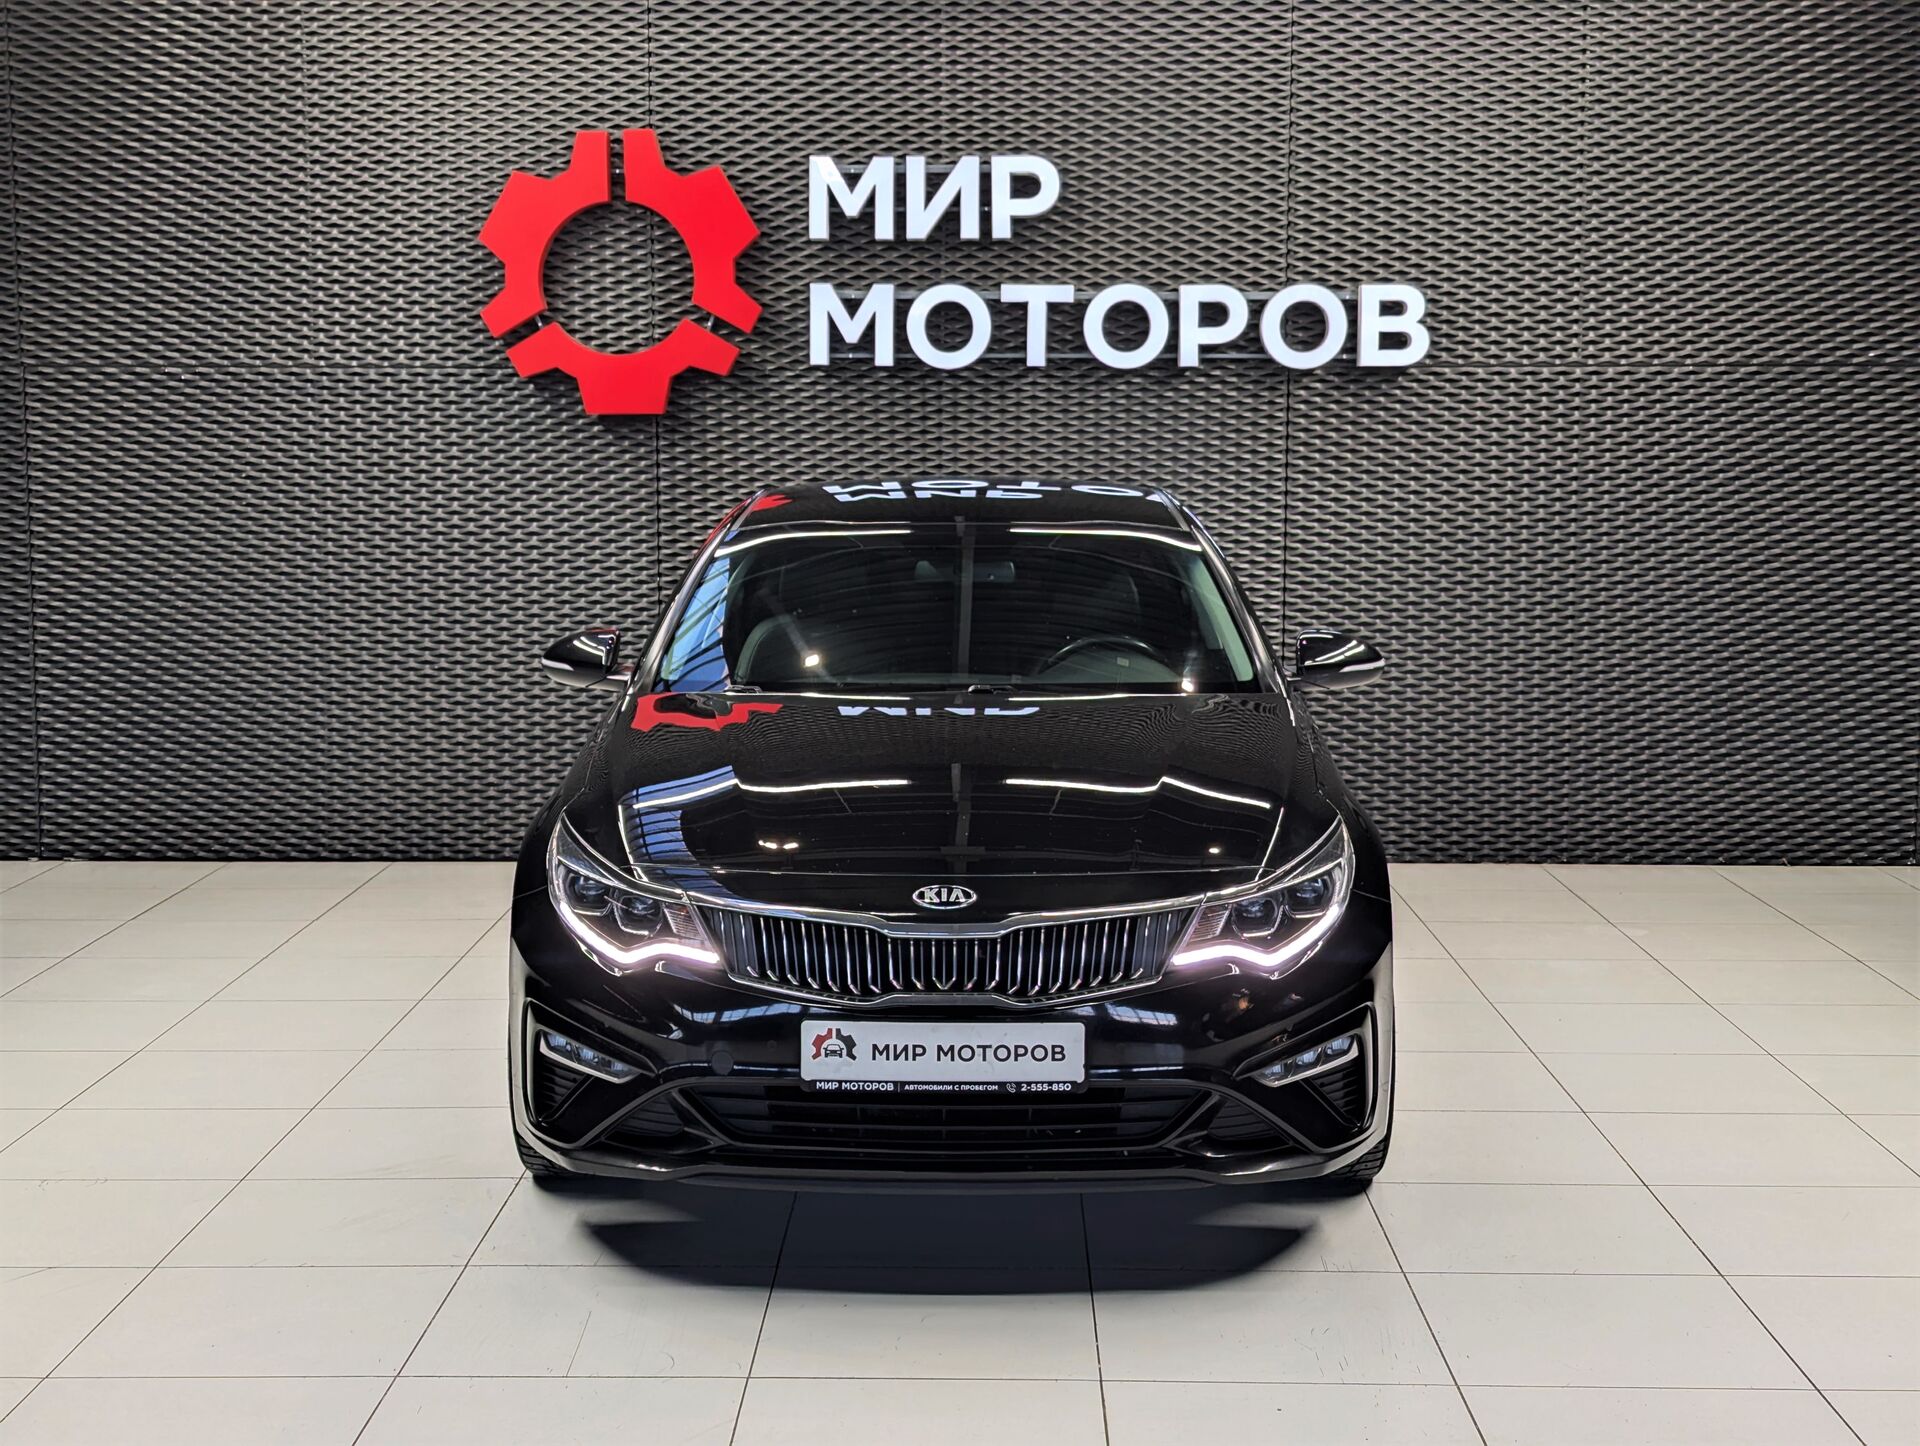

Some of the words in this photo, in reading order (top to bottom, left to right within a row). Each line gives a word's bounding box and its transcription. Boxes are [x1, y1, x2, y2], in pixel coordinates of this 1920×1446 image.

[808, 154, 1061, 241] МИР
[808, 282, 1432, 370] МОТОРОВ
[922, 887, 966, 903] KIA
[871, 1043, 927, 1062] МИР
[936, 1044, 1066, 1063] МОТОРОВ
[816, 1081, 839, 1090] МИР
[841, 1082, 894, 1091] МОТОРОВ
[1020, 1083, 1072, 1092] 2-555-850
